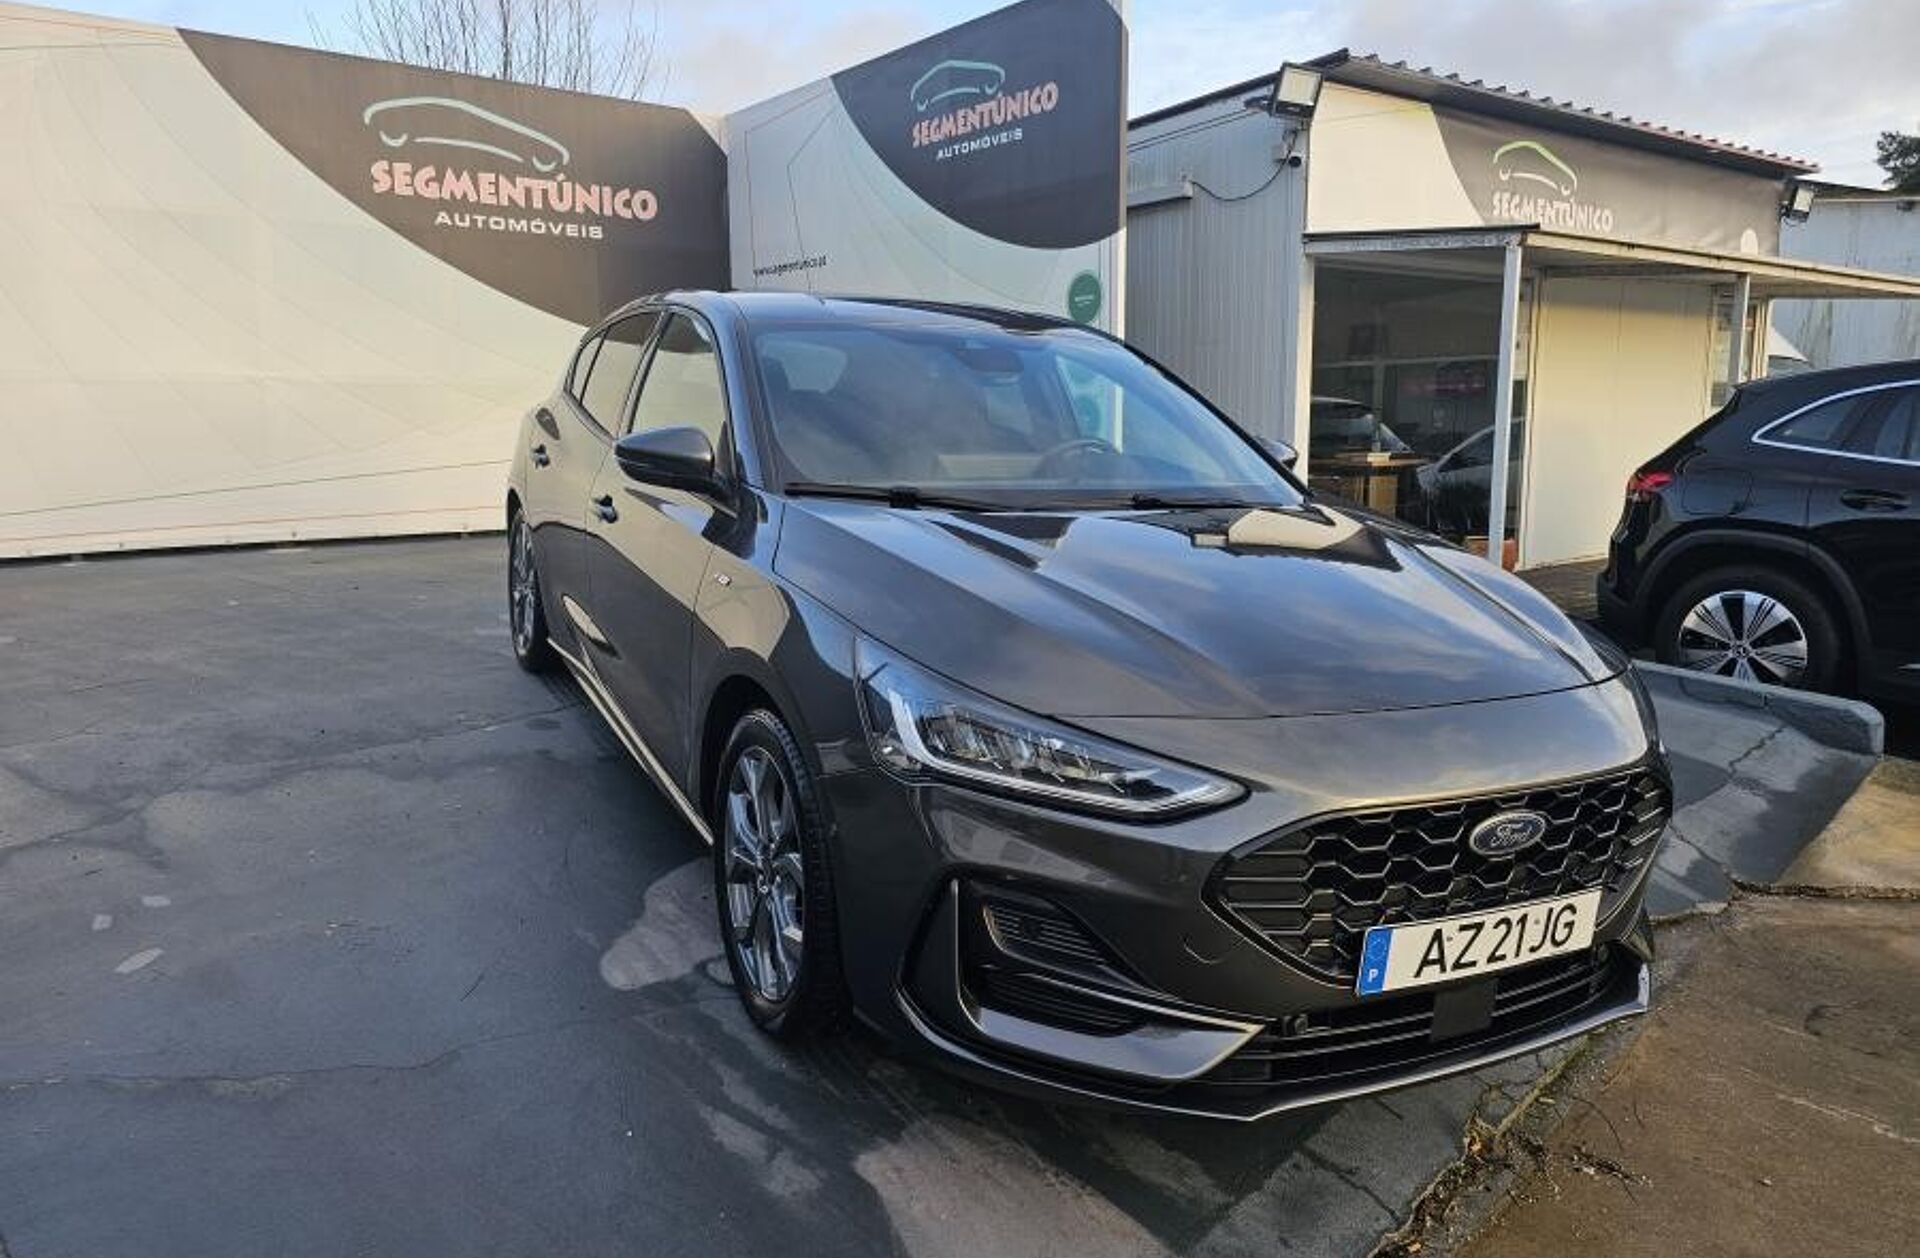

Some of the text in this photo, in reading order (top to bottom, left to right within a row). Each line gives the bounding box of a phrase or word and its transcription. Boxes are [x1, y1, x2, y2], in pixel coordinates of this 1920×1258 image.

[912, 81, 1059, 148] SEGMENTÚNICO
[370, 160, 658, 220] SEGMENTÚNICO
[1493, 192, 1614, 233] SEGMENTÚNICO
[434, 211, 604, 239] AUTOMÓVEIS
